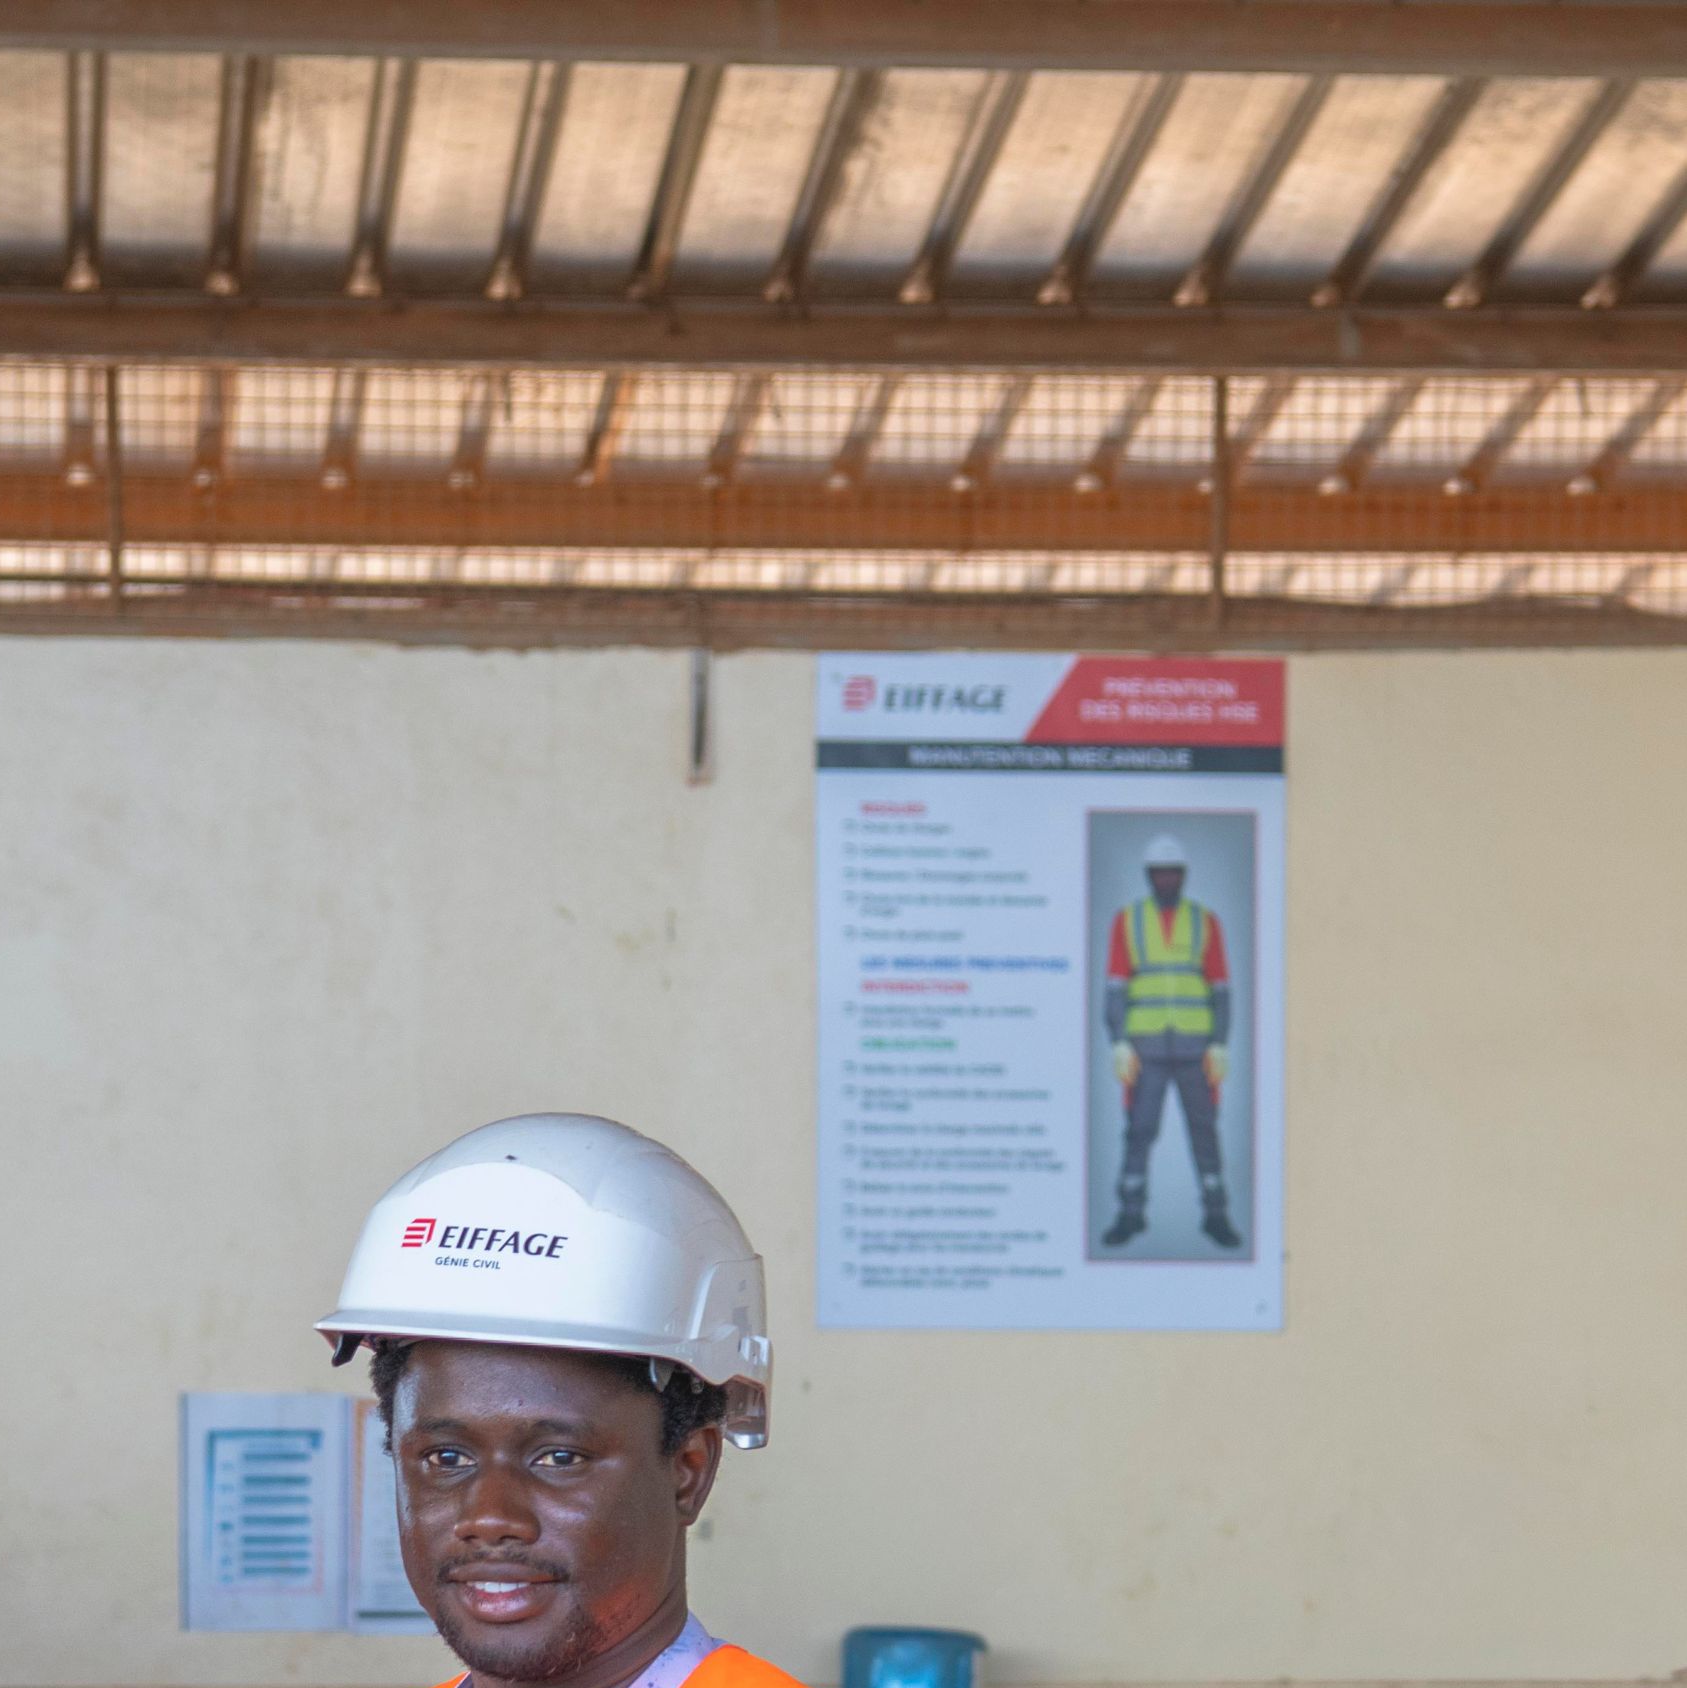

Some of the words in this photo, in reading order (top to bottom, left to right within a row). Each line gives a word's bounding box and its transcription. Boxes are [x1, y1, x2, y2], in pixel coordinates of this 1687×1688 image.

[884, 684, 1006, 712] EIFFAGE
[1079, 699, 1122, 721] DES
[908, 746, 1062, 767] MANUTENTION
[437, 1225, 569, 1259] EIFFAGE
[434, 1254, 470, 1268] GÉNIE
[471, 1259, 501, 1270] CIVIL
